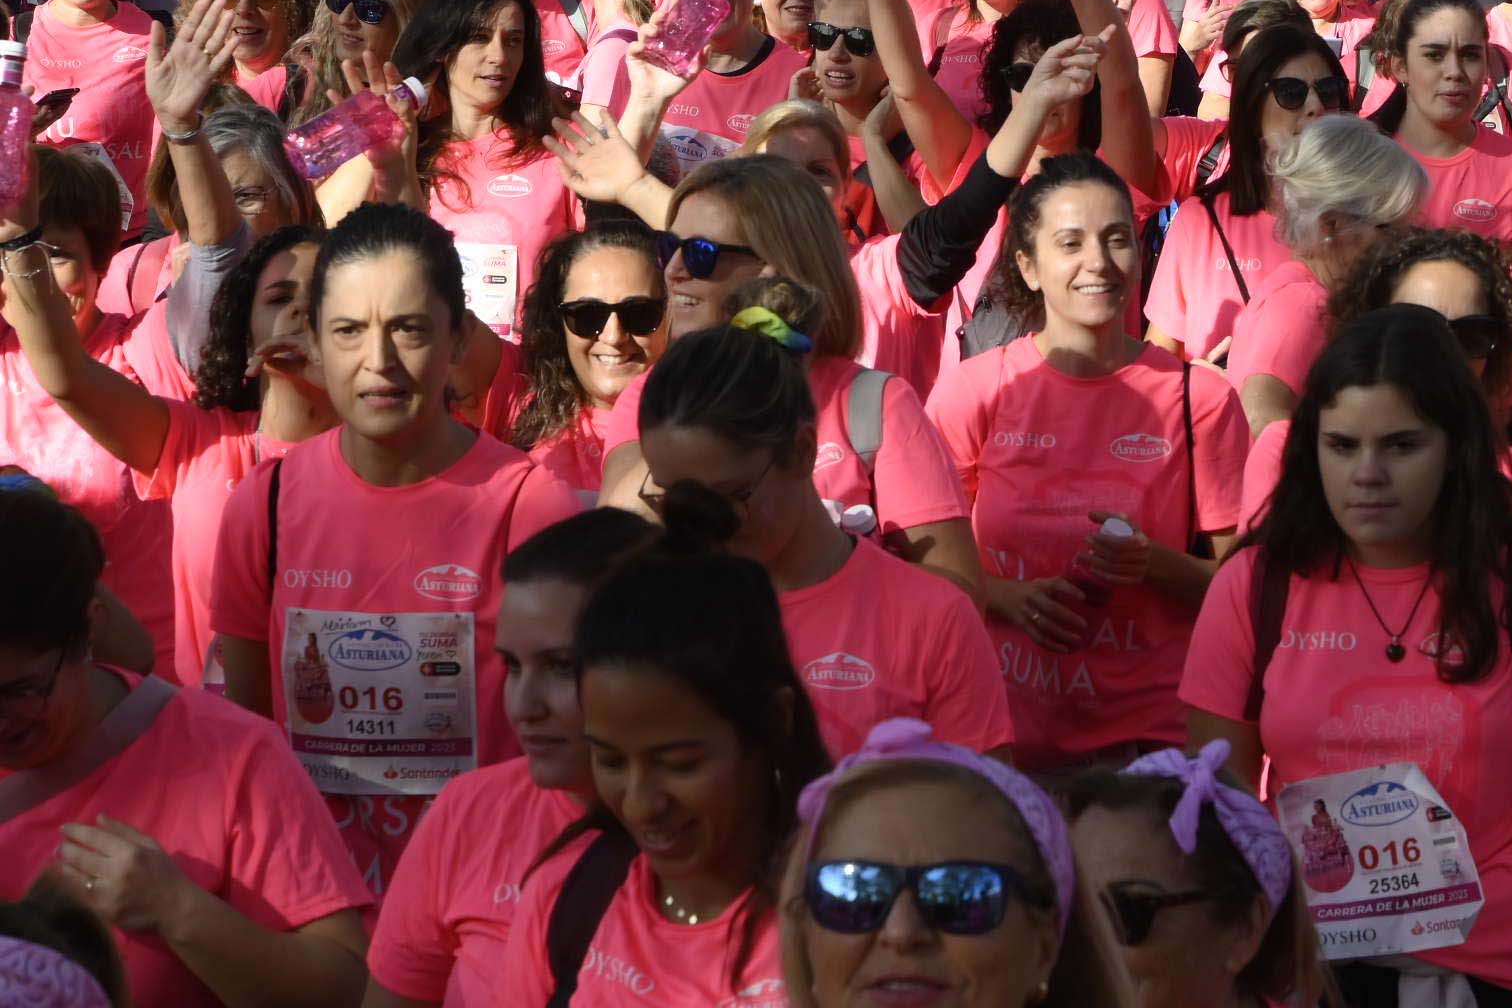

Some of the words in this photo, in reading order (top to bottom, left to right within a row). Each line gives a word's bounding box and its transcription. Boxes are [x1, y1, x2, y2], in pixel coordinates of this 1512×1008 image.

[667, 102, 699, 119] YSHO
[108, 139, 144, 160] SAL
[994, 431, 1056, 449] OYSHO
[1114, 442, 1169, 456] ASTURIANA
[283, 568, 353, 589] OYSHO
[420, 573, 481, 592] ASTURIANA
[335, 643, 406, 661] ASTURIANA
[420, 637, 458, 649] SUMA
[808, 666, 868, 682] ASTURIANA
[1000, 640, 1096, 697] SUMA
[338, 685, 404, 713] 016
[346, 718, 396, 735] 14311
[349, 742, 366, 753] DE
[368, 742, 384, 753] LA
[386, 742, 426, 753] MUJER
[1346, 799, 1416, 821] ASTURIANA
[1358, 837, 1421, 870] 016
[1369, 871, 1420, 895] 25364
[1317, 903, 1374, 920] CARRERA
[1376, 900, 1393, 912] DE
[1395, 898, 1410, 910] LA
[1411, 893, 1446, 908] MUJER
